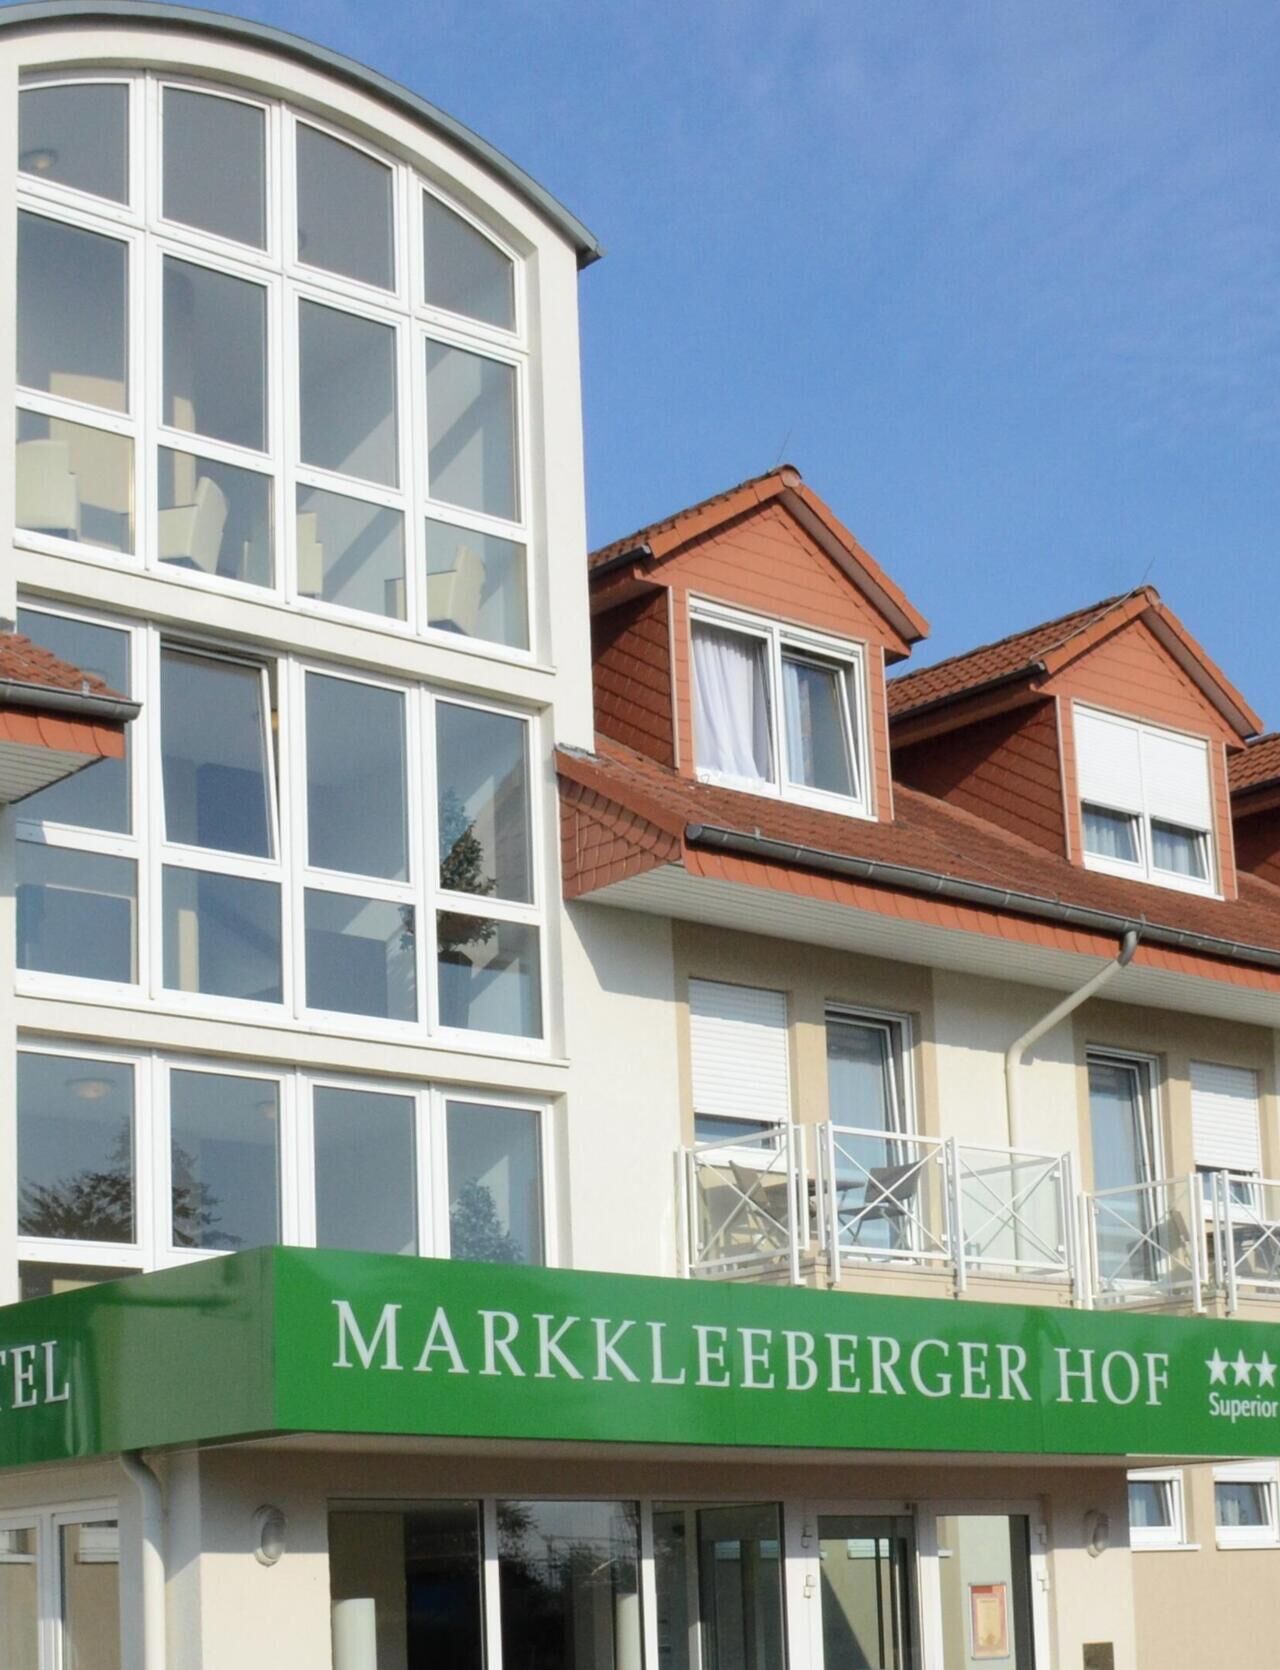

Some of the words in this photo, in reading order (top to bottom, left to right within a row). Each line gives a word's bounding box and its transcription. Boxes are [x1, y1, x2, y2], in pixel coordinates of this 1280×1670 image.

[331, 1299, 1033, 1401] MARKKLEEBERGER
[1053, 1347, 1170, 1406] HOF
[1208, 1391, 1279, 1423] Superior
